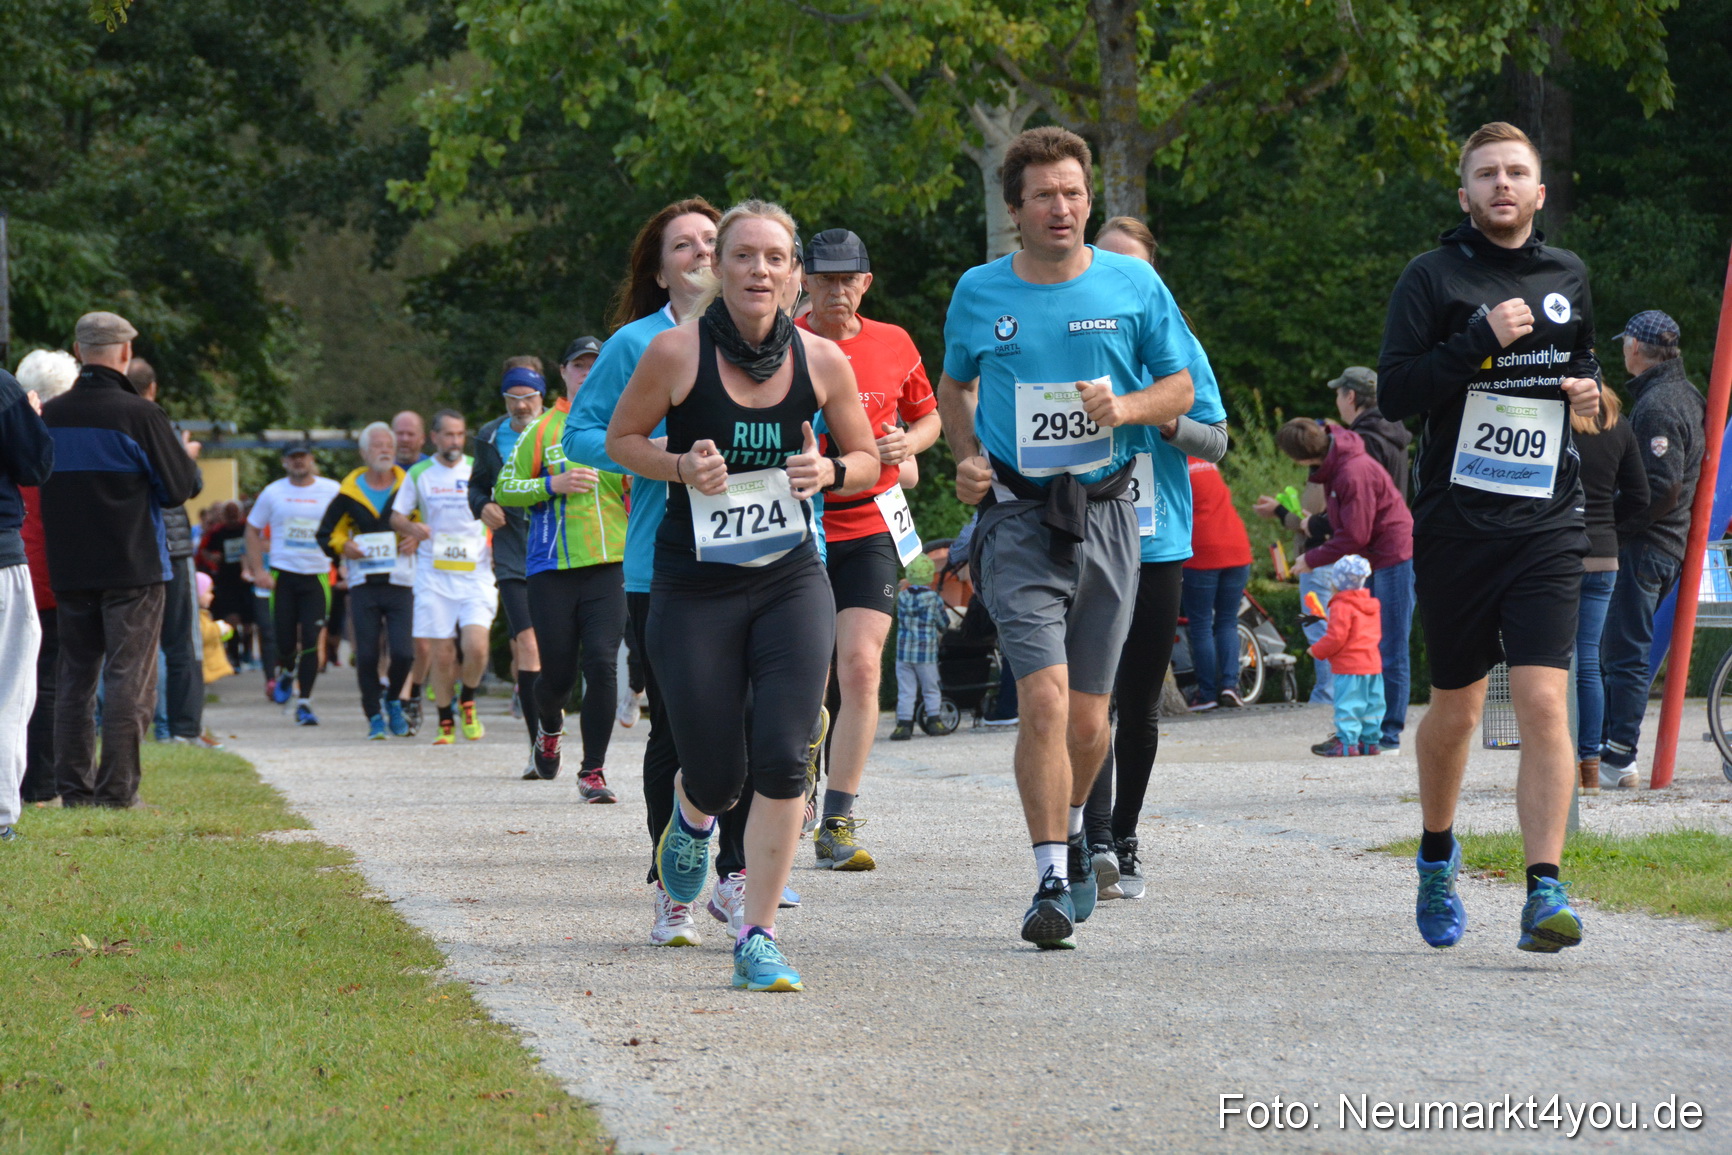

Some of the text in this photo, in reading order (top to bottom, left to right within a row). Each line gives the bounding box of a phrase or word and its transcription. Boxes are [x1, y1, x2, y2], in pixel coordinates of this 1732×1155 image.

[1068, 318, 1118, 332] BOCK
[1054, 391, 1081, 401] BOC
[1506, 406, 1537, 417] BOCK
[1032, 411, 1100, 441] 2935
[733, 422, 781, 449] RUN
[1474, 423, 1546, 459] 2909
[1461, 457, 1540, 480] Alexander
[728, 480, 765, 494] BOCK
[710, 500, 787, 539] 2724
[444, 546, 467, 559] 404
